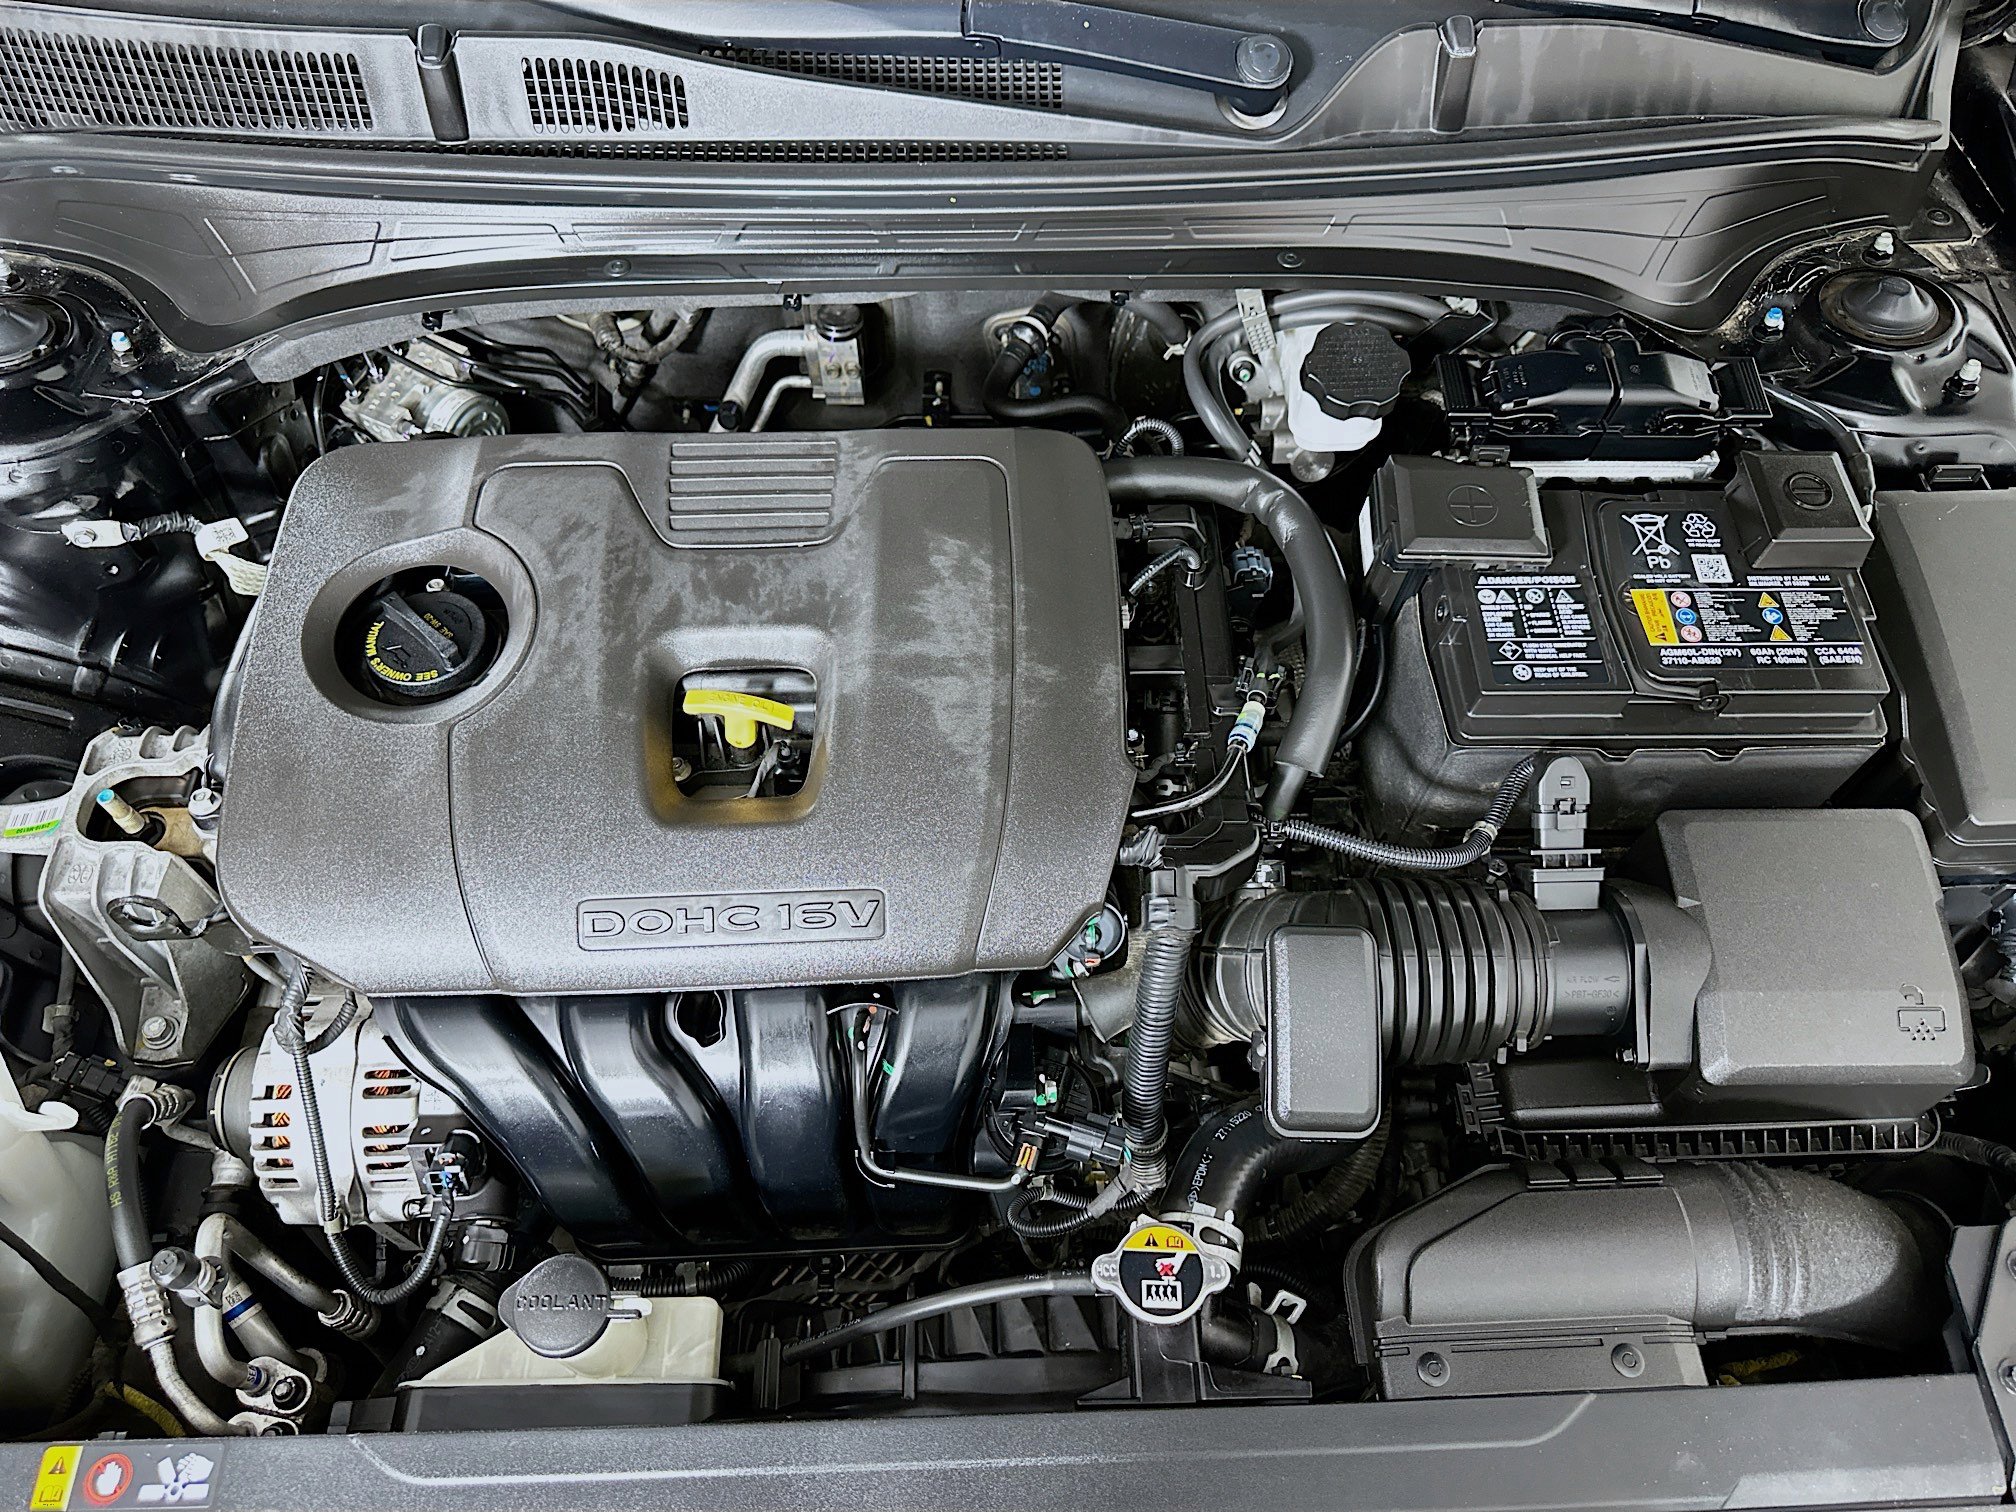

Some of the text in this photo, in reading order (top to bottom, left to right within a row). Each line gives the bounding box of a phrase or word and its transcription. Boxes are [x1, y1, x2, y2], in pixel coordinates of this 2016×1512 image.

[1646, 556, 1671, 569] Pb
[1487, 576, 1576, 584] DANGER/POISON
[365, 621, 438, 681] SEE OWNER'S MANUAL
[1776, 647, 1808, 657] (20HR)
[1814, 648, 1836, 656] CCA
[1756, 656, 1772, 664] RC
[1773, 656, 1807, 664] 100min
[1819, 655, 1863, 665] (SAE/EN)
[583, 900, 880, 937] DOHC 16V
[110, 1191, 122, 1208] HS
[1096, 1263, 1117, 1277] HCC
[1209, 1265, 1226, 1279] 1.1
[516, 1294, 608, 1311] COOLANT
